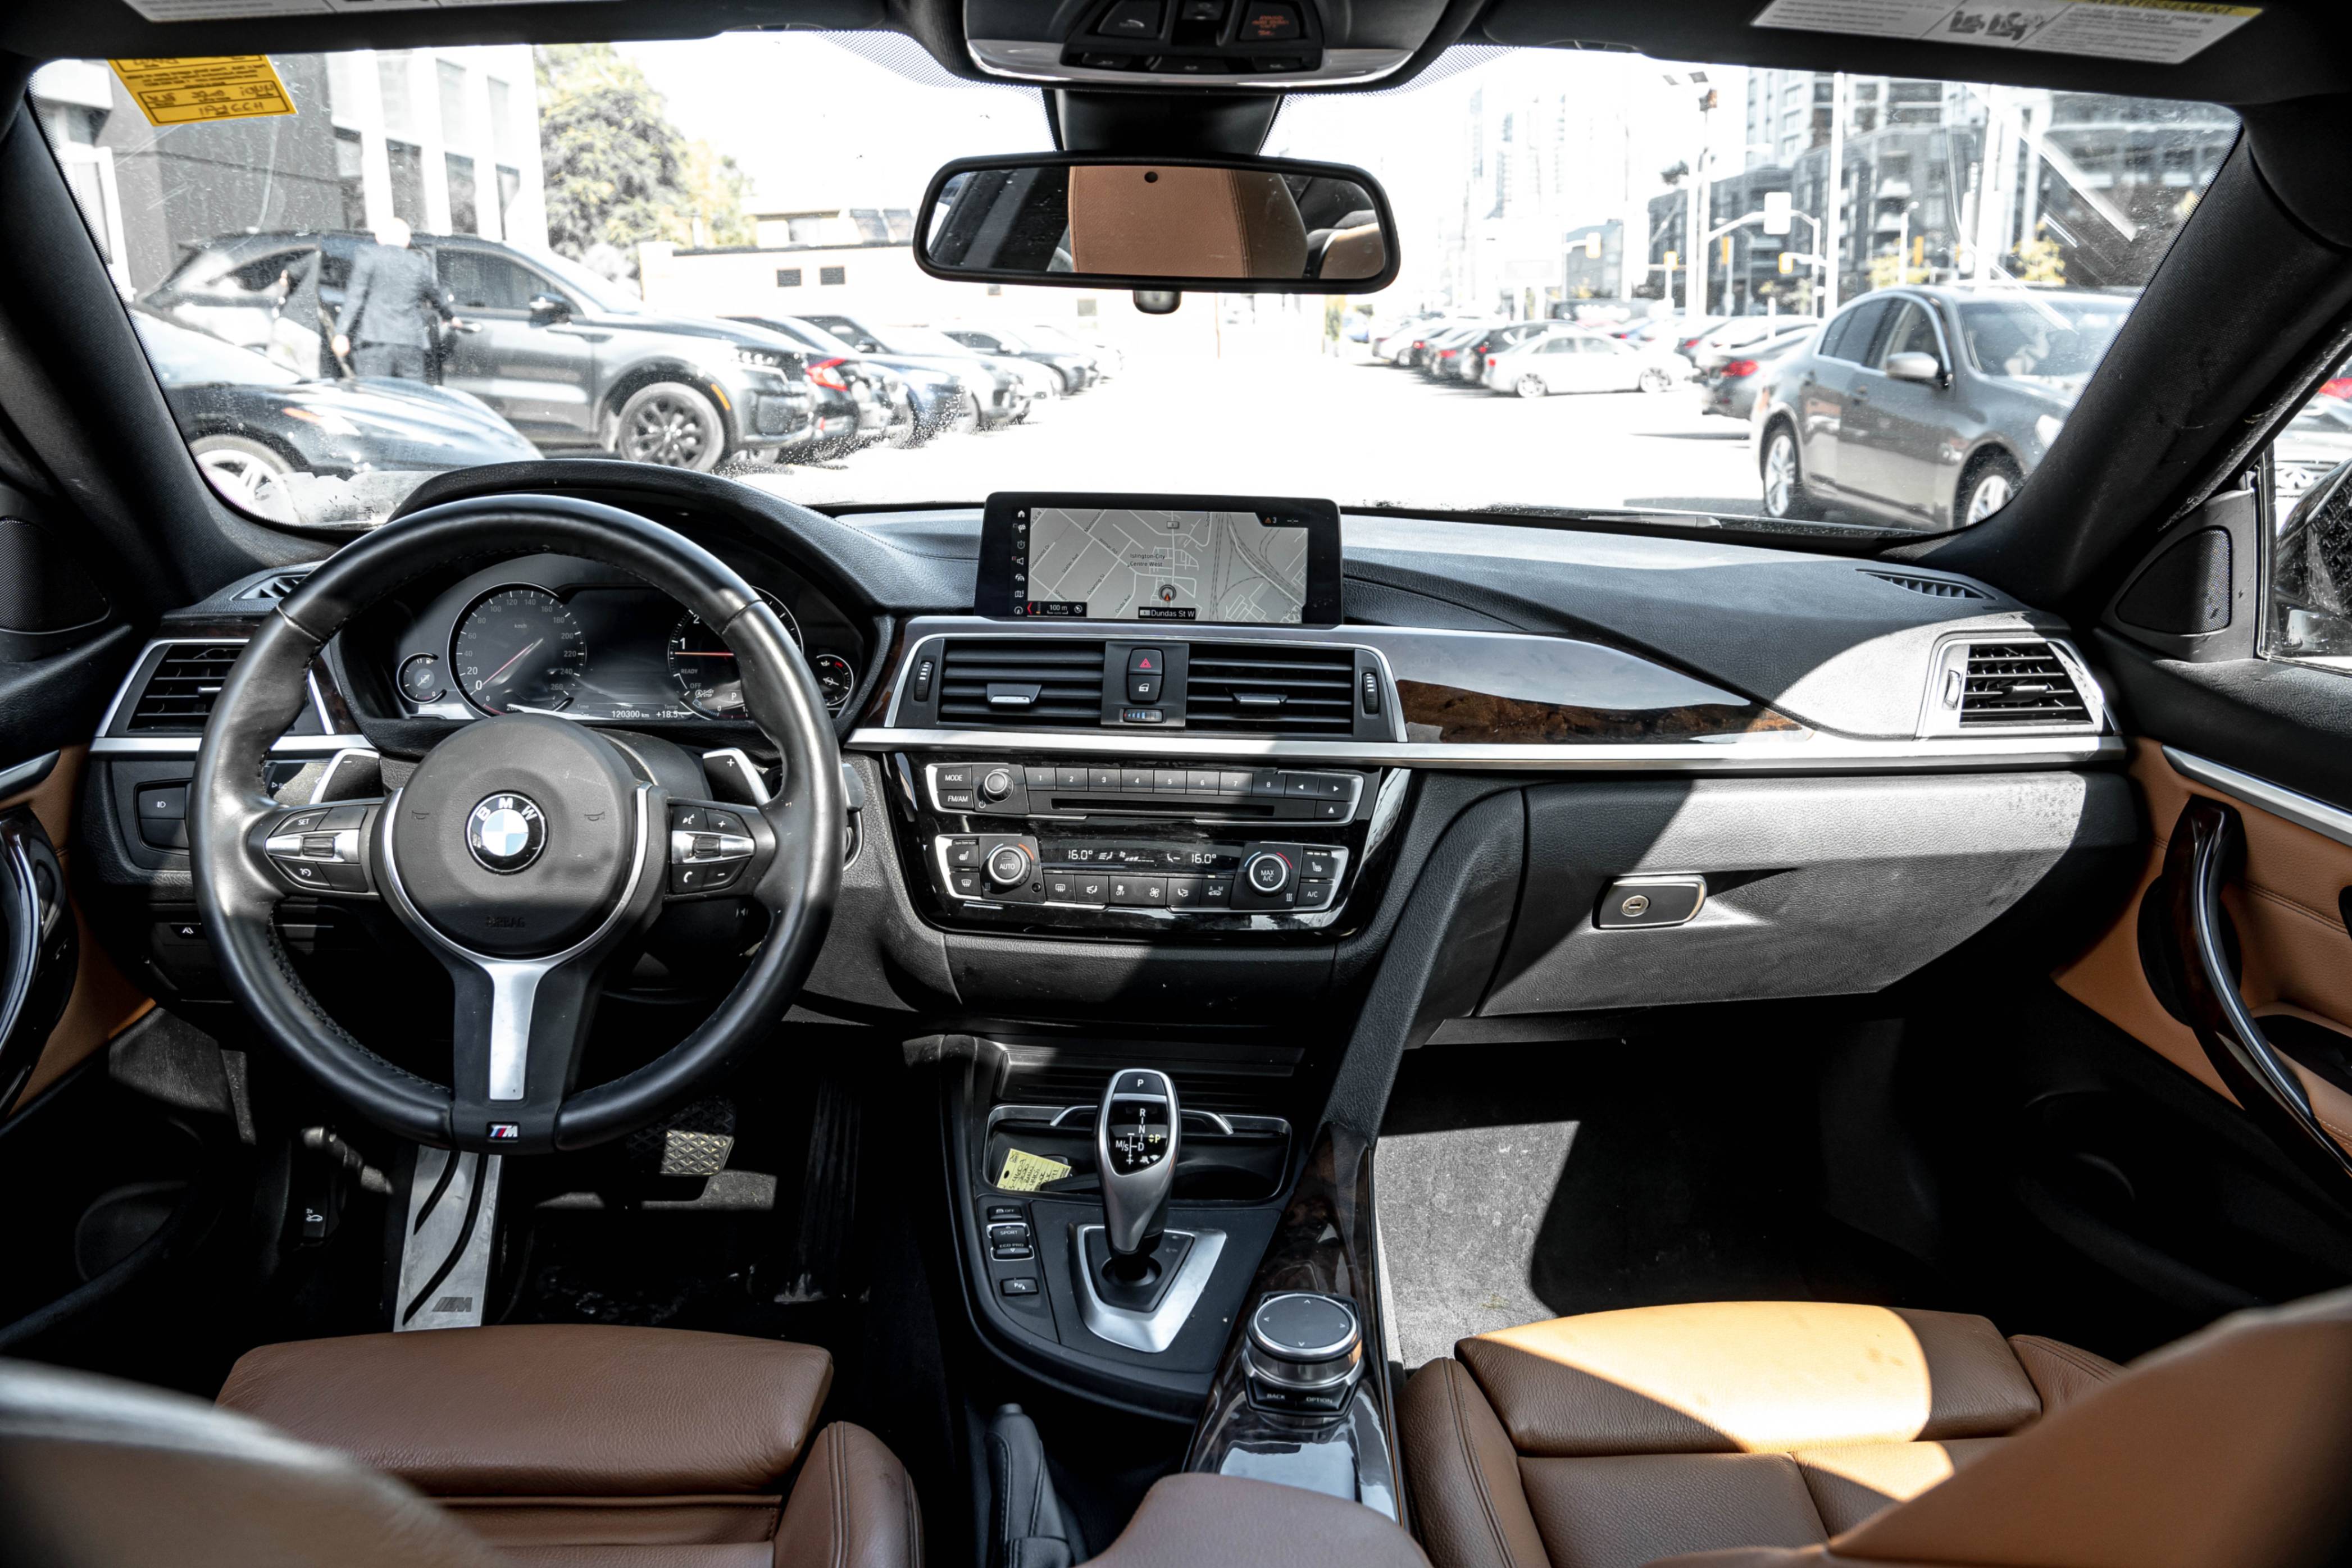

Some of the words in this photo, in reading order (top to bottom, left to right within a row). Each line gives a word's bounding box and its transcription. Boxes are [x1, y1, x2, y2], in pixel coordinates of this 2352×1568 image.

[1086, 577, 1102, 595] Downing
[1123, 594, 1131, 603] Ave
[693, 614, 700, 624] 2
[680, 637, 685, 649] 1
[475, 680, 482, 690] 0
[731, 692, 737, 700] P
[476, 797, 538, 822] BMW
[1068, 850, 1093, 859] 16.0°
[1191, 854, 1217, 864] 16.0°
[1139, 1109, 1146, 1117] R
[497, 1124, 518, 1137] M
[1139, 1125, 1145, 1133] N
[1155, 1134, 1161, 1143] P
[1116, 1140, 1129, 1151] M/S
[1138, 1142, 1144, 1151] D
[442, 1297, 473, 1312] M
